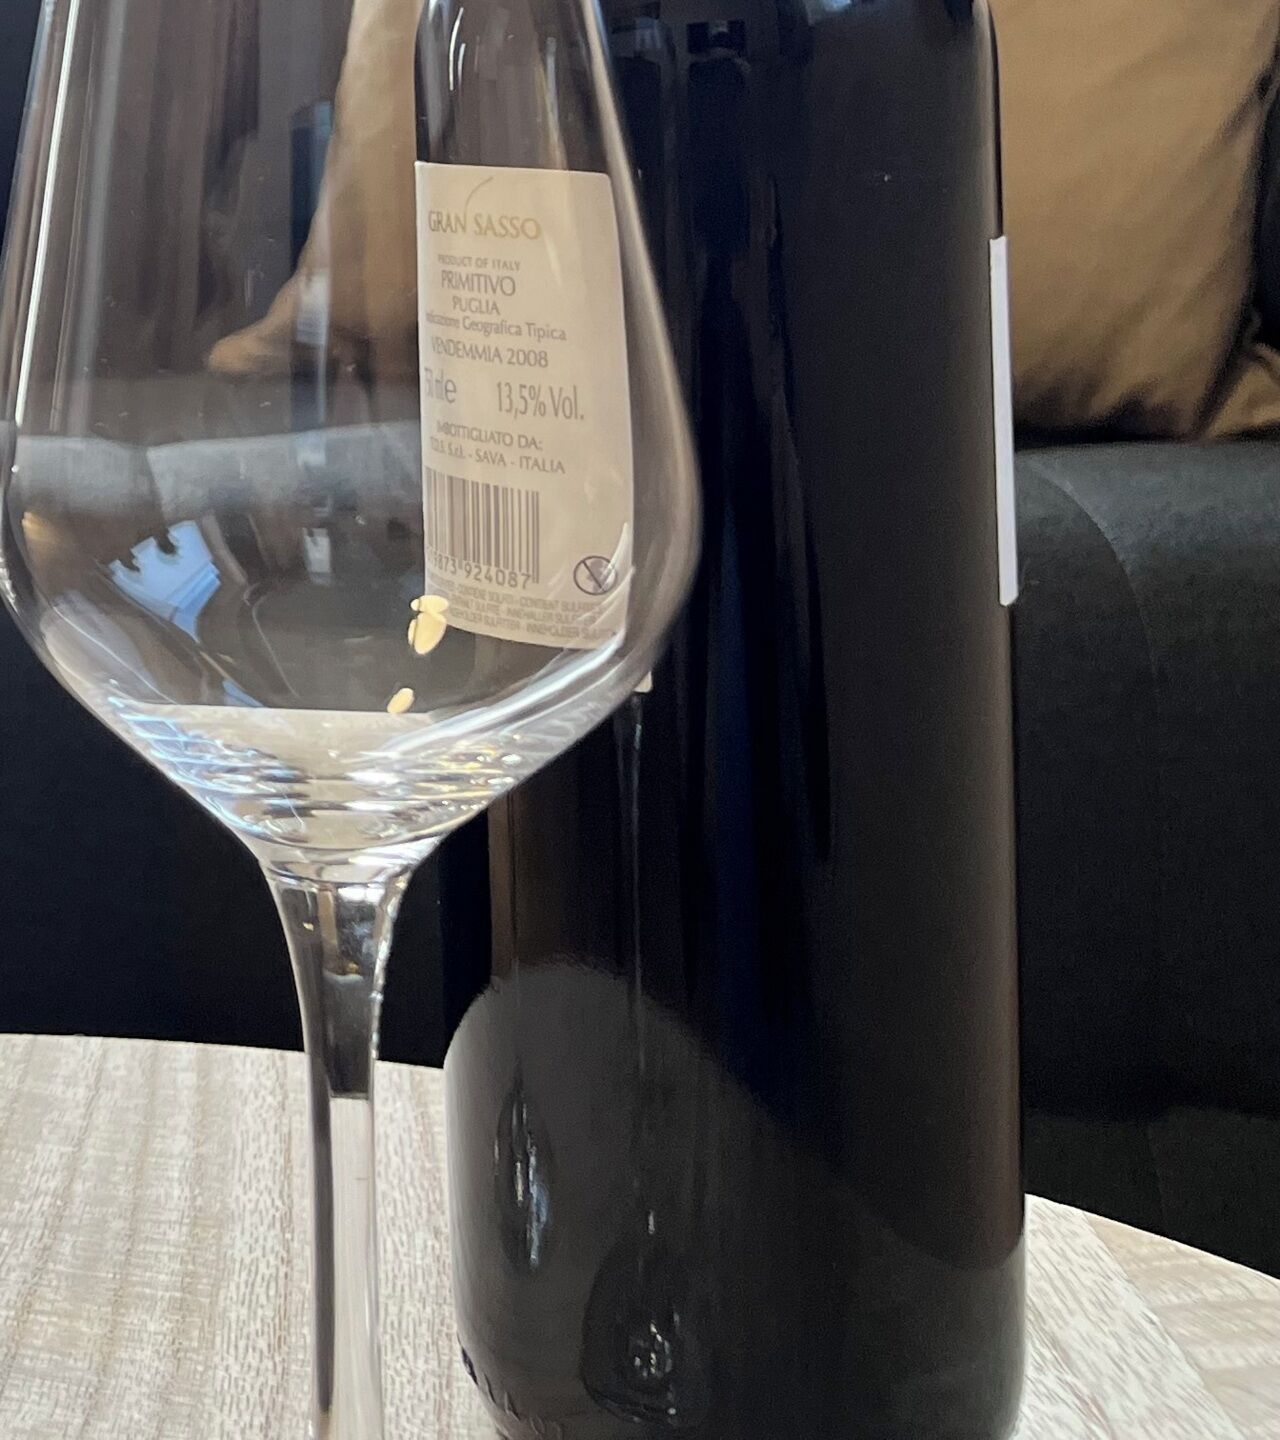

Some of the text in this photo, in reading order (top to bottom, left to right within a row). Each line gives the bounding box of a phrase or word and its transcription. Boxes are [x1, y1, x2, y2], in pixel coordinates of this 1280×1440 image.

[428, 210, 542, 240] GRAN SASSO
[475, 258, 488, 269] OF
[492, 259, 521, 271] ITALY
[441, 270, 516, 296] PRIMITIVO
[452, 296, 501, 316] PUGLIA
[462, 316, 522, 337] Geografica
[525, 322, 567, 343] Tipica
[431, 336, 548, 368] VENDEMMIA 2008
[497, 381, 546, 420] 13,5%
[549, 384, 584, 421] Vol.
[518, 435, 543, 451] DA:
[476, 448, 507, 467] SAVA
[519, 456, 566, 474] ITALIA
[464, 563, 531, 590] 924087
